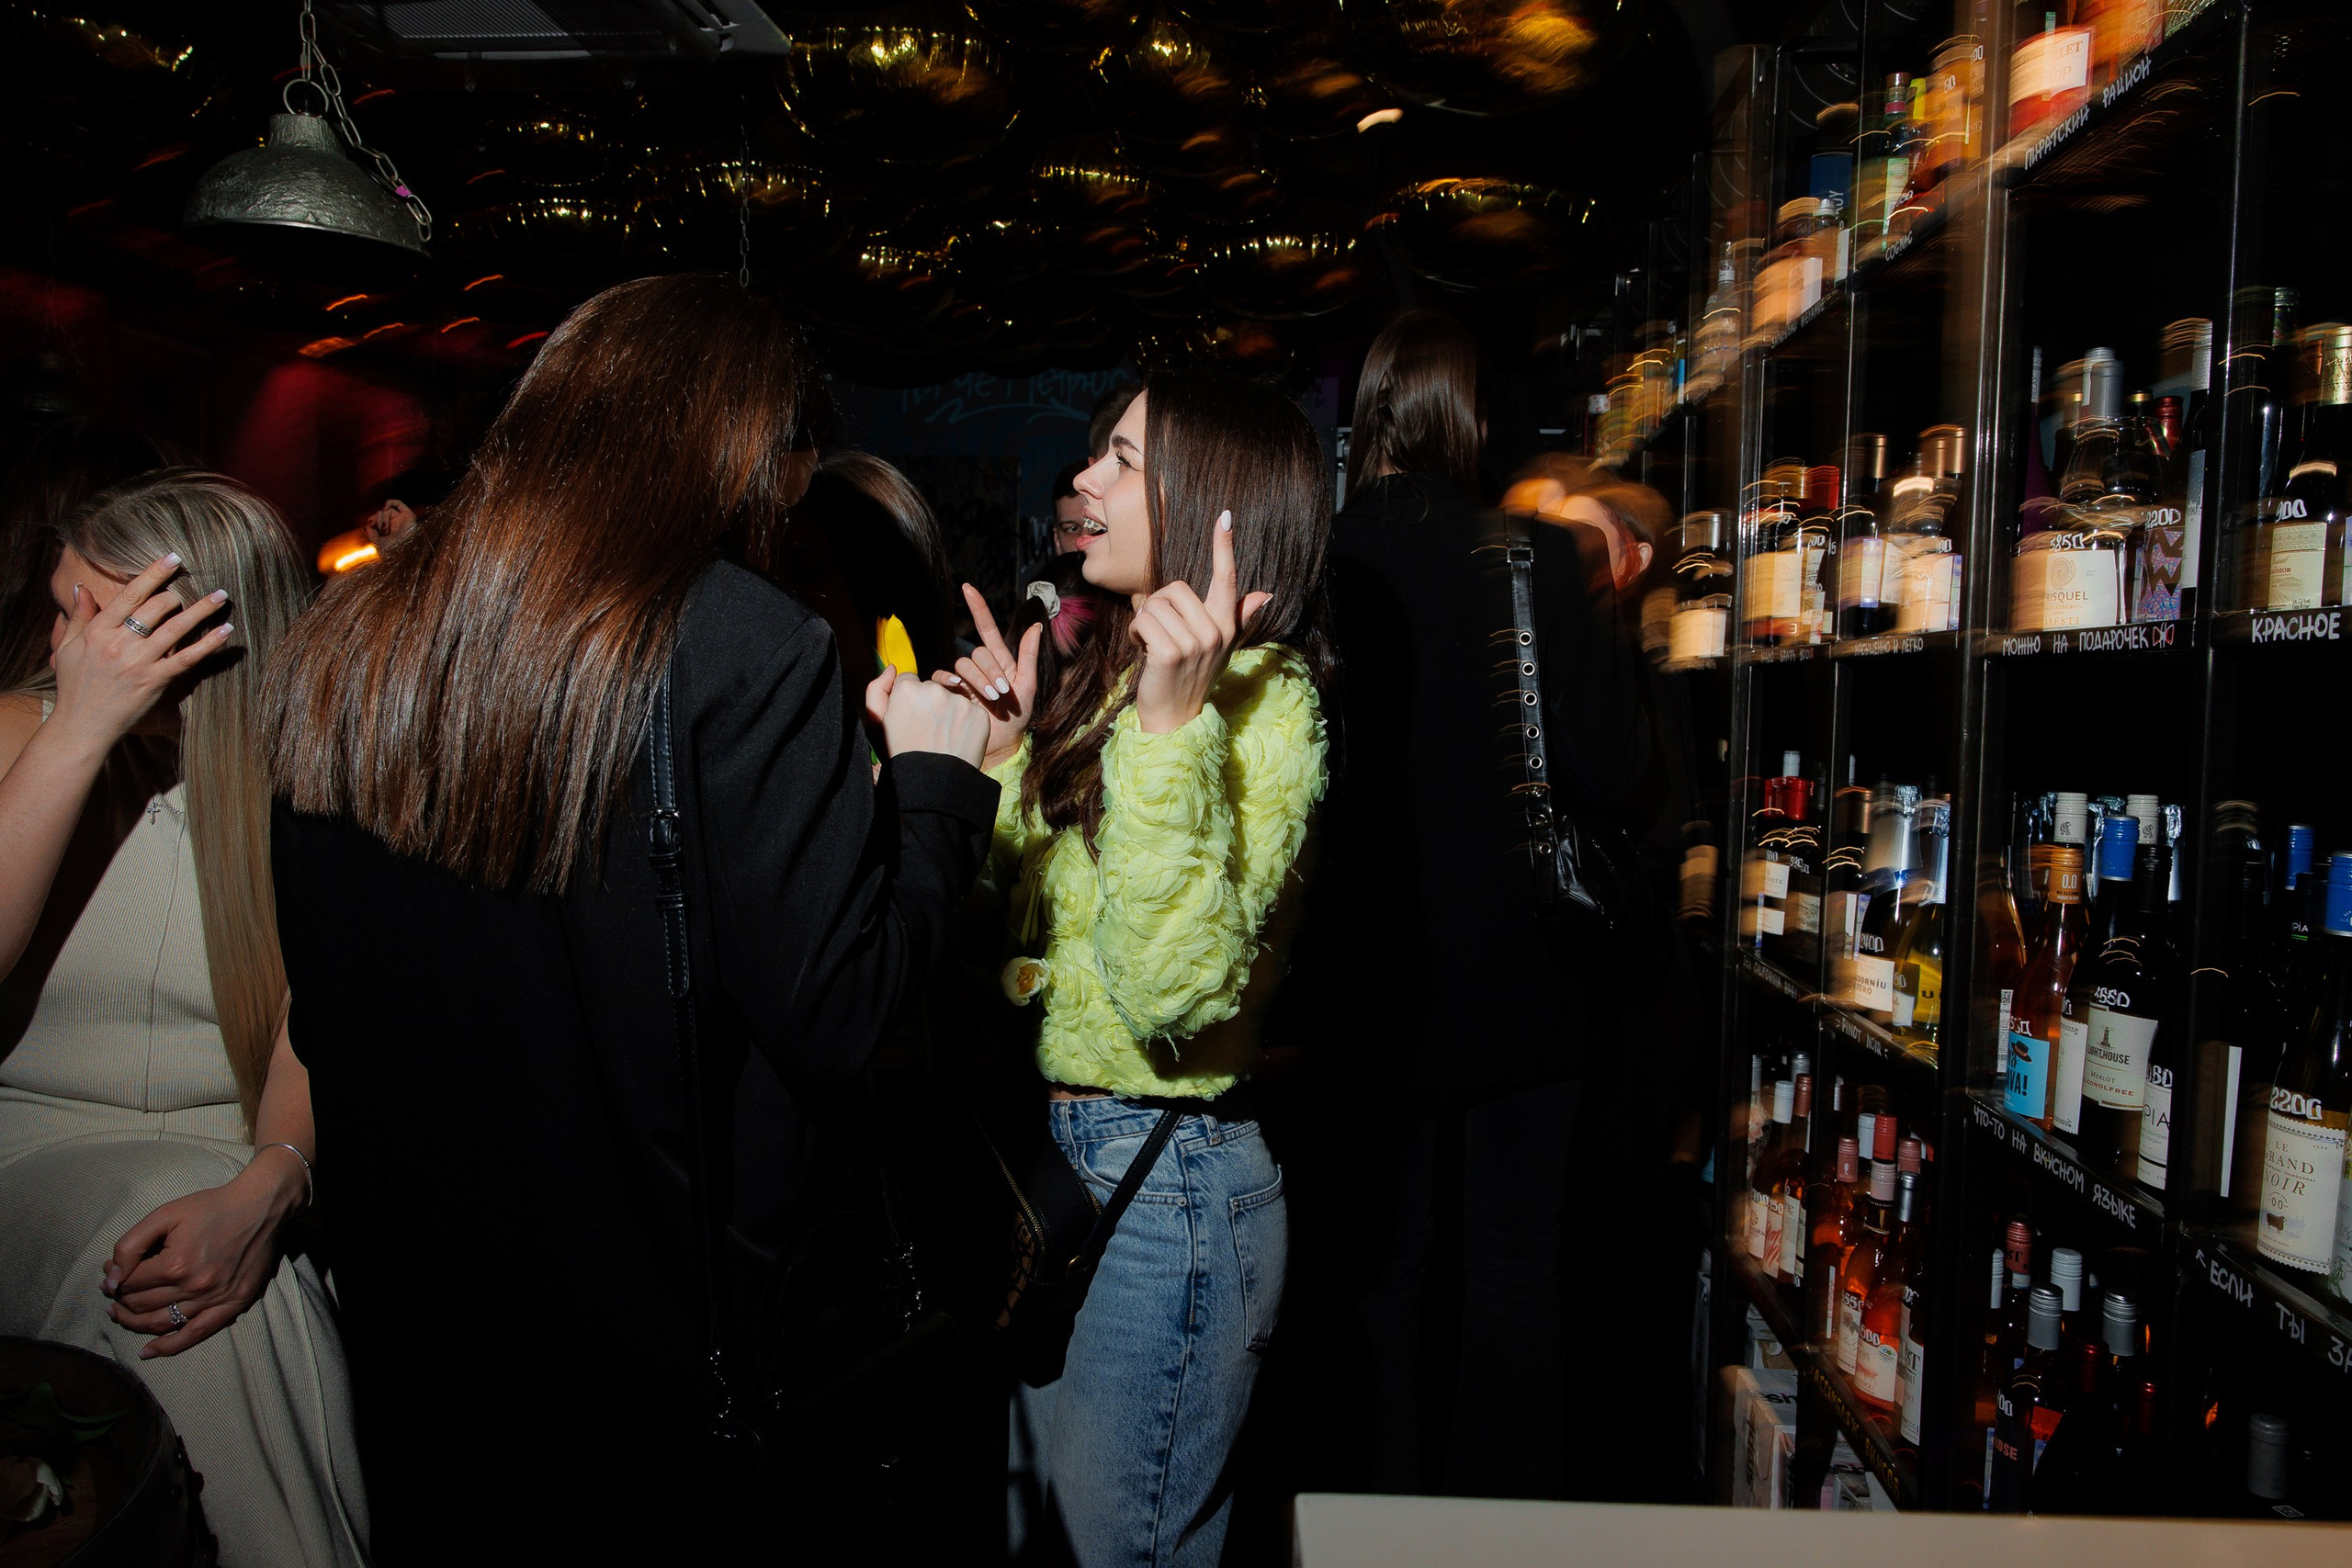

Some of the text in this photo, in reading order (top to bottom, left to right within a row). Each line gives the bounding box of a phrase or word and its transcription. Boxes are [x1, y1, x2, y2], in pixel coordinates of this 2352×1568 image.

[2102, 56, 2152, 108] РАЦИОН
[1885, 230, 1913, 262] COGNAC
[2045, 591, 2089, 603] RISQUEL
[2002, 626, 2150, 657] МОЖНО НА ПОДАРОЧЕК
[2251, 612, 2342, 644] КРАСНОЕ
[1840, 1016, 1883, 1057] PINOT NOIR
[2269, 1086, 2323, 1120] 2200
[2275, 1140, 2289, 1153] LE
[1973, 1104, 2137, 1229] ЧТО-ТО НА ВКУСНОМ ЯЗЫКЕ
[2264, 1168, 2306, 1196] NOIR
[2210, 1259, 2254, 1308] ЕСЛИ
[2275, 1301, 2305, 1345] ТЫ
